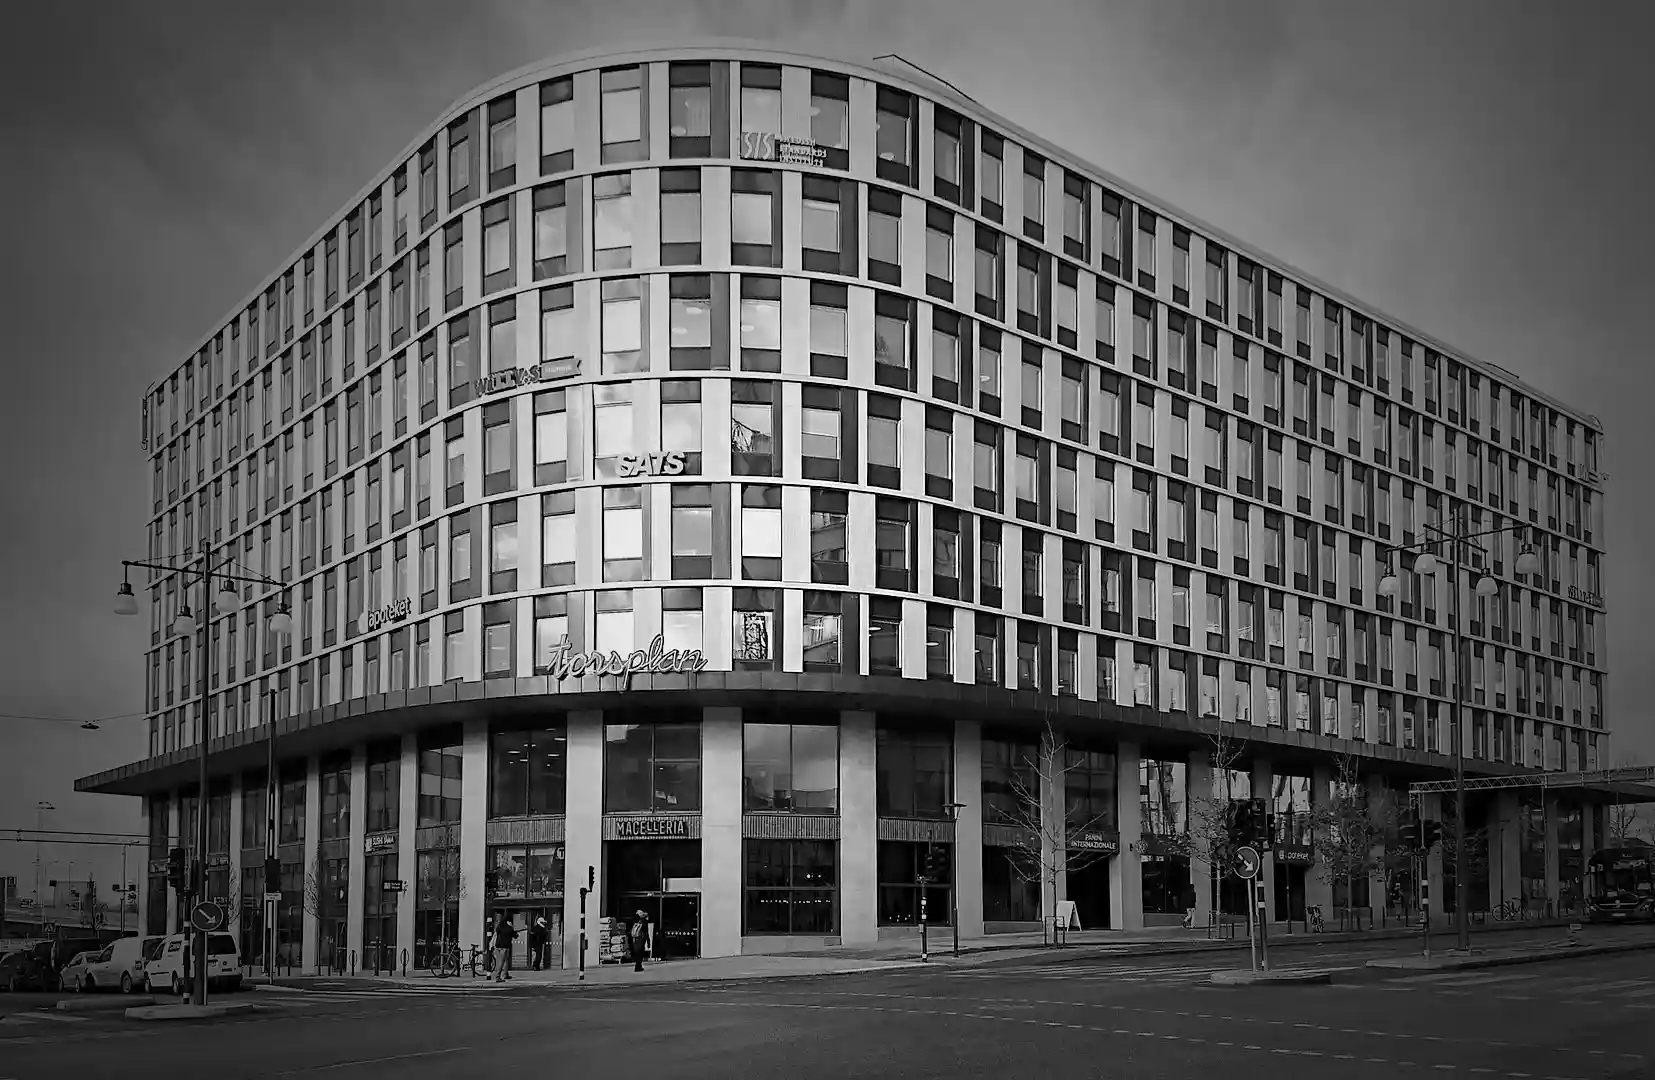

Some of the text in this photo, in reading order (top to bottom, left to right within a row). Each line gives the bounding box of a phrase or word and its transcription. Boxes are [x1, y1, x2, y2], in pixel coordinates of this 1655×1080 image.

[742, 132, 773, 159] SIS
[615, 451, 685, 477] SATS
[369, 597, 411, 630] apoteket
[546, 634, 708, 690] torsplan
[616, 820, 684, 835] MACELLERIA
